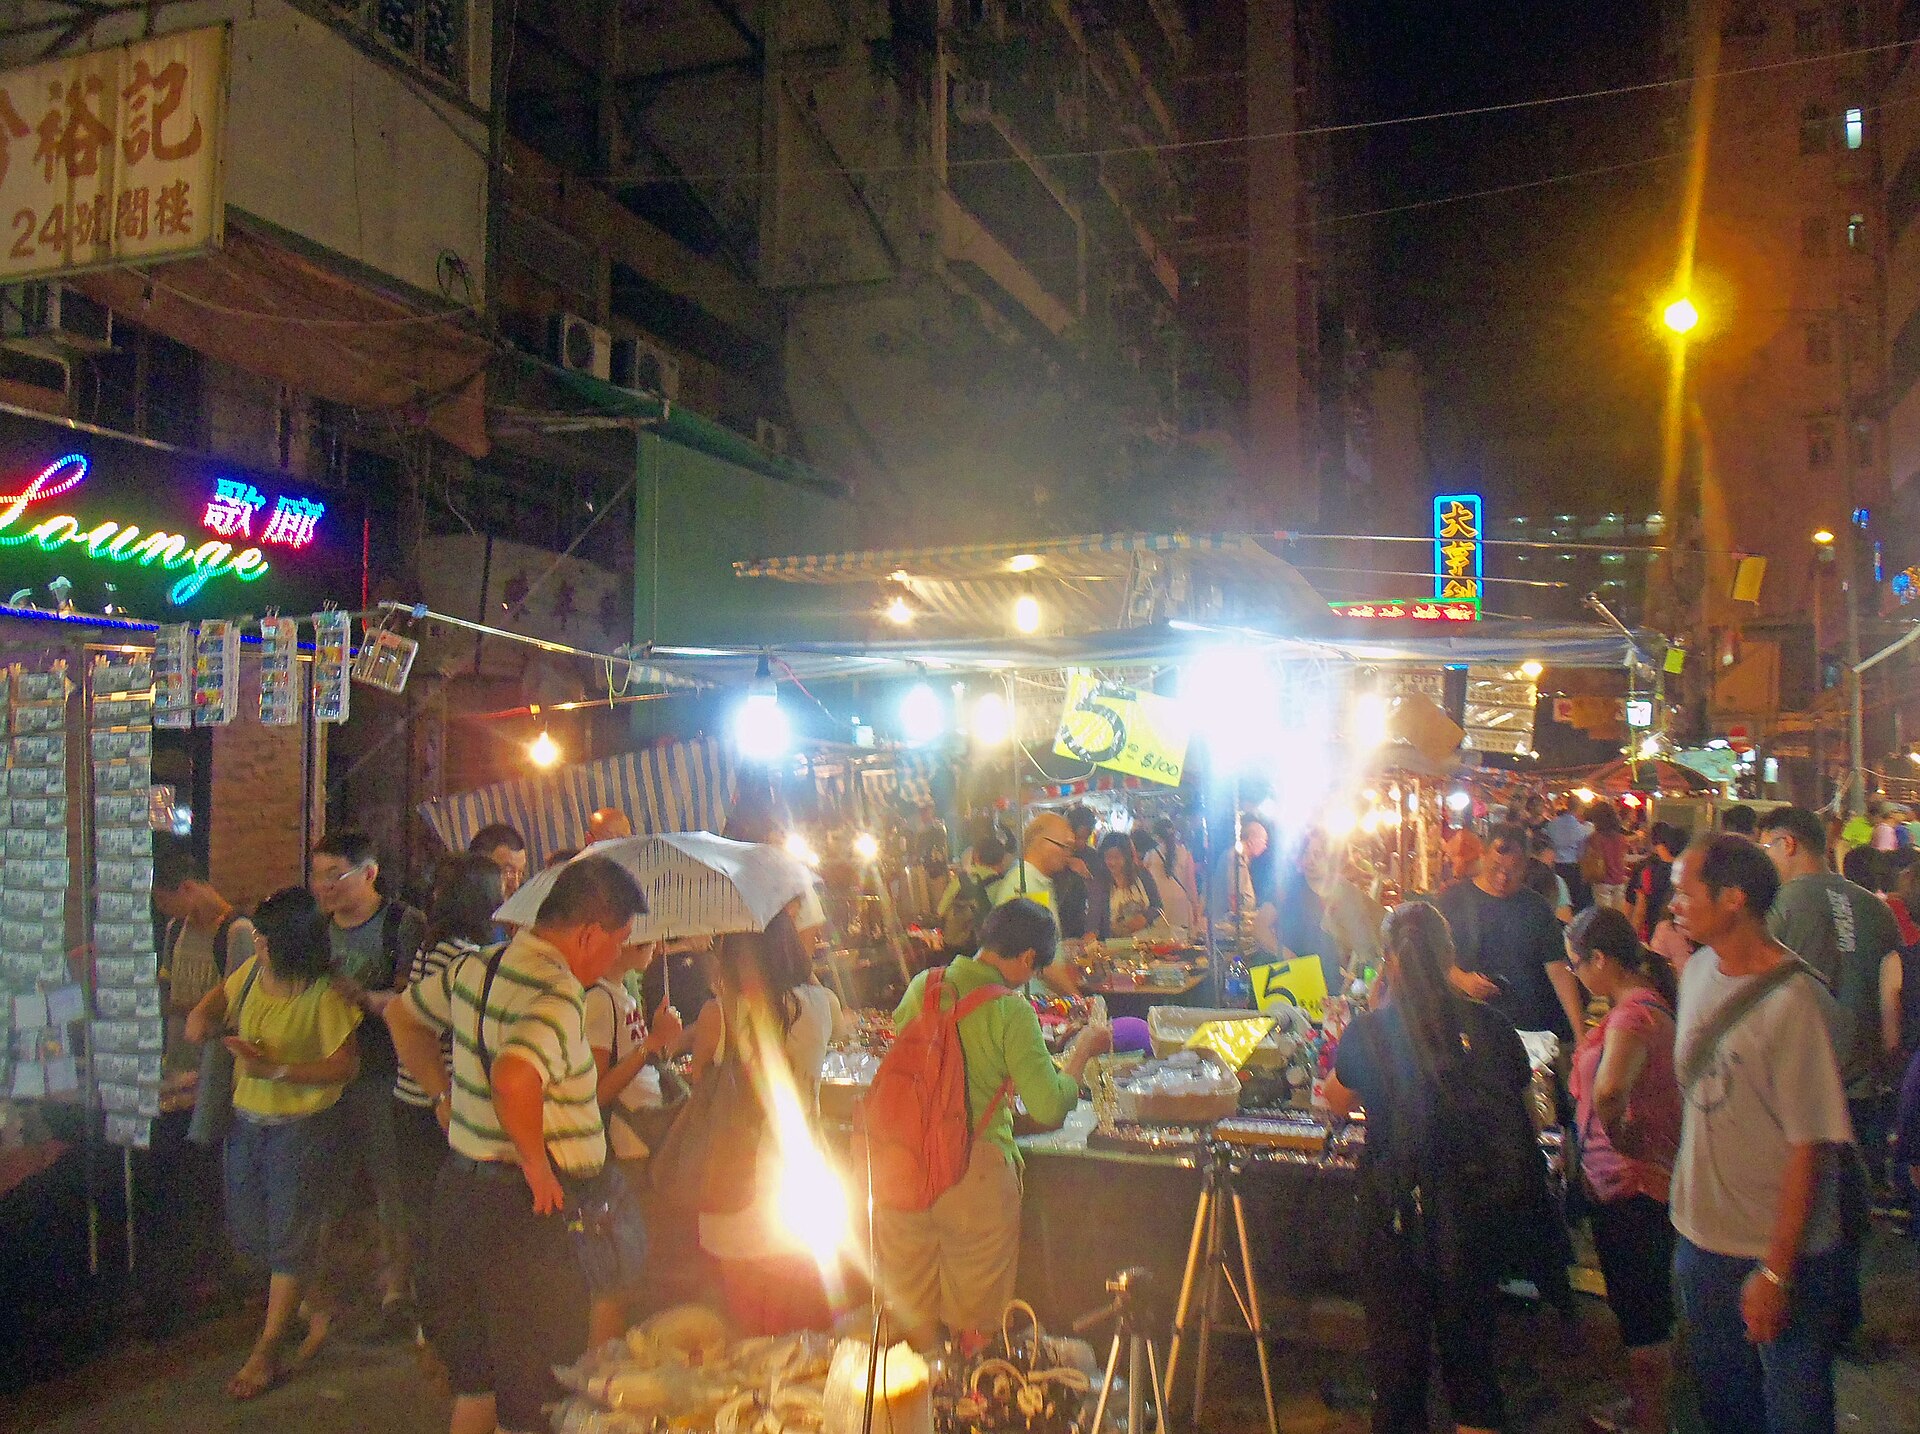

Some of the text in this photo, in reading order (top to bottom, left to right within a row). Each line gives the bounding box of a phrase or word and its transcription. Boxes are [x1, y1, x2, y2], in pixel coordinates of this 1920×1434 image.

[0, 453, 270, 606] Lounge
[1060, 679, 1137, 763] 5
[1140, 752, 1179, 777] $100
